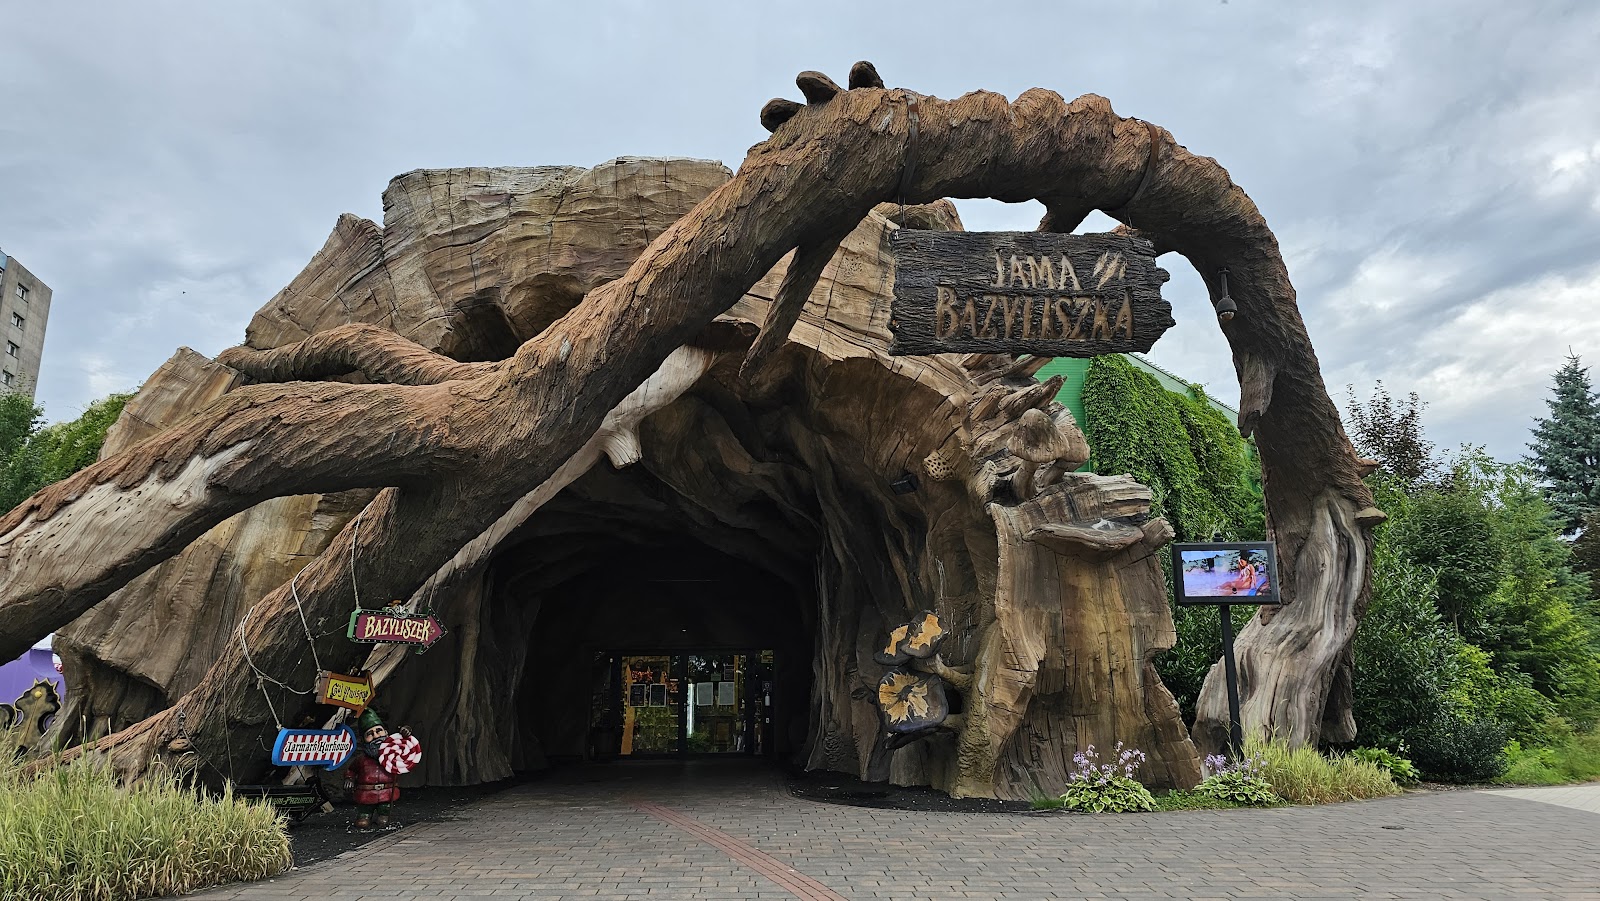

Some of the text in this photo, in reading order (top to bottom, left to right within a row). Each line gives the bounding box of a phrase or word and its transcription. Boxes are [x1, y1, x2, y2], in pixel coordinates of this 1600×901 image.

[991, 249, 1082, 291] JAMA
[935, 285, 1135, 341] BAZYLISZKA
[364, 615, 431, 642] BAZYLISZEK
